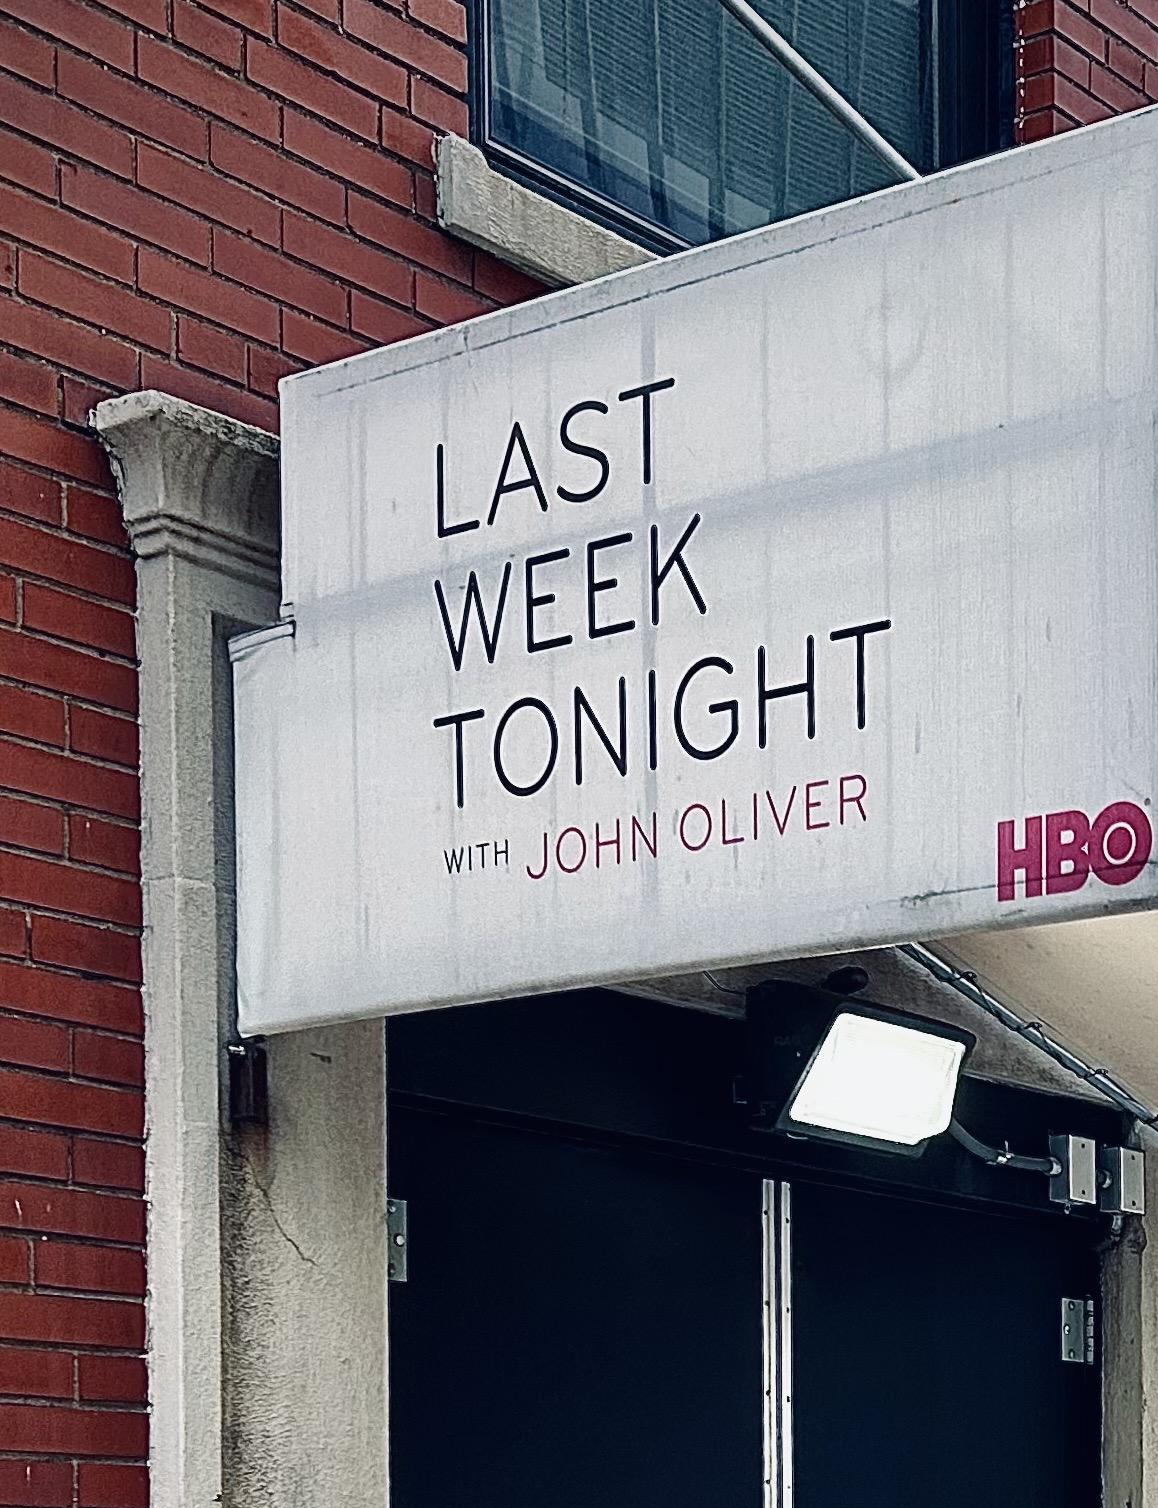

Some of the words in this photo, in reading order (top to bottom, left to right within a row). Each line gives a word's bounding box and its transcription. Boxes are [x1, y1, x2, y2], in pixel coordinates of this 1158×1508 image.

[436, 377, 676, 539] LAST
[433, 512, 708, 672] WEEK
[432, 618, 892, 810] TONIGHT
[443, 838, 510, 875] WITH
[525, 810, 658, 880] JOHN
[679, 774, 868, 852] OLIVER
[996, 800, 1154, 902] HBO
